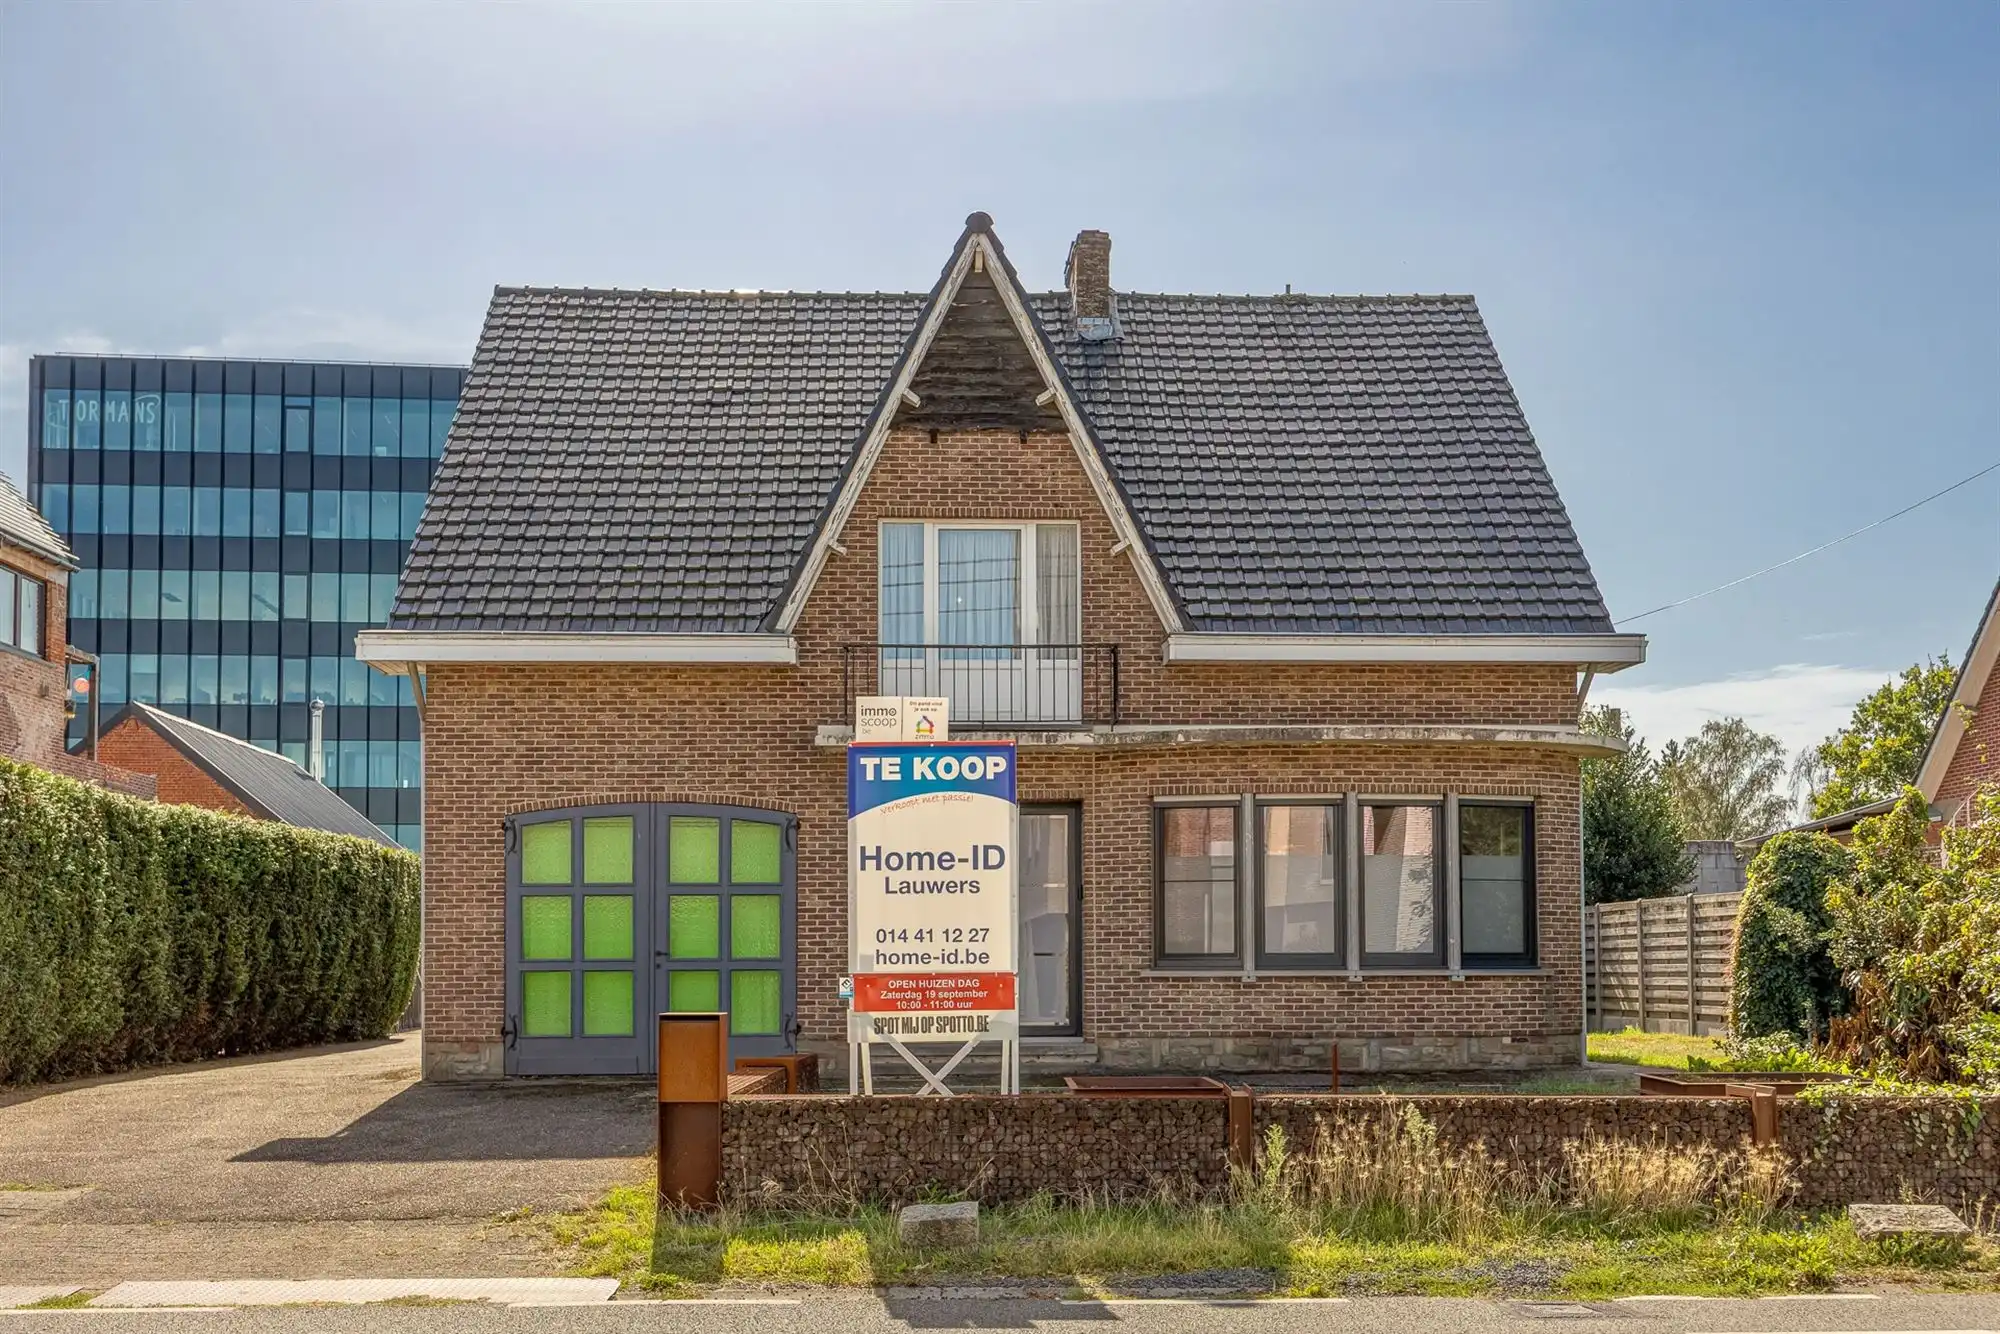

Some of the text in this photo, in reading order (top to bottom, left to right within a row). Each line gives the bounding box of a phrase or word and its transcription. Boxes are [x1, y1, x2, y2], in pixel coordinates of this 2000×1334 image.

[58, 399, 156, 424] TORMANS
[860, 705, 897, 717] immo
[860, 718, 897, 728] scoop
[860, 756, 1007, 781] TE KOOP
[880, 797, 920, 815] verkoopt
[922, 795, 940, 804] met
[860, 845, 1006, 872] Home-ID
[885, 876, 981, 895] Lauwers
[876, 928, 990, 943] 014 41 12 27
[875, 949, 990, 965] home-id.be
[888, 979, 980, 989] OPEN HUIZEN DAG
[880, 990, 988, 1000] Zaterdag 19 september
[896, 1001, 921, 1009] 10:00
[930, 1001, 954, 1009] 11:00
[956, 1001, 973, 1009] uur
[873, 1015, 990, 1035] SPOT MIJ OP SPOTTO.BE
